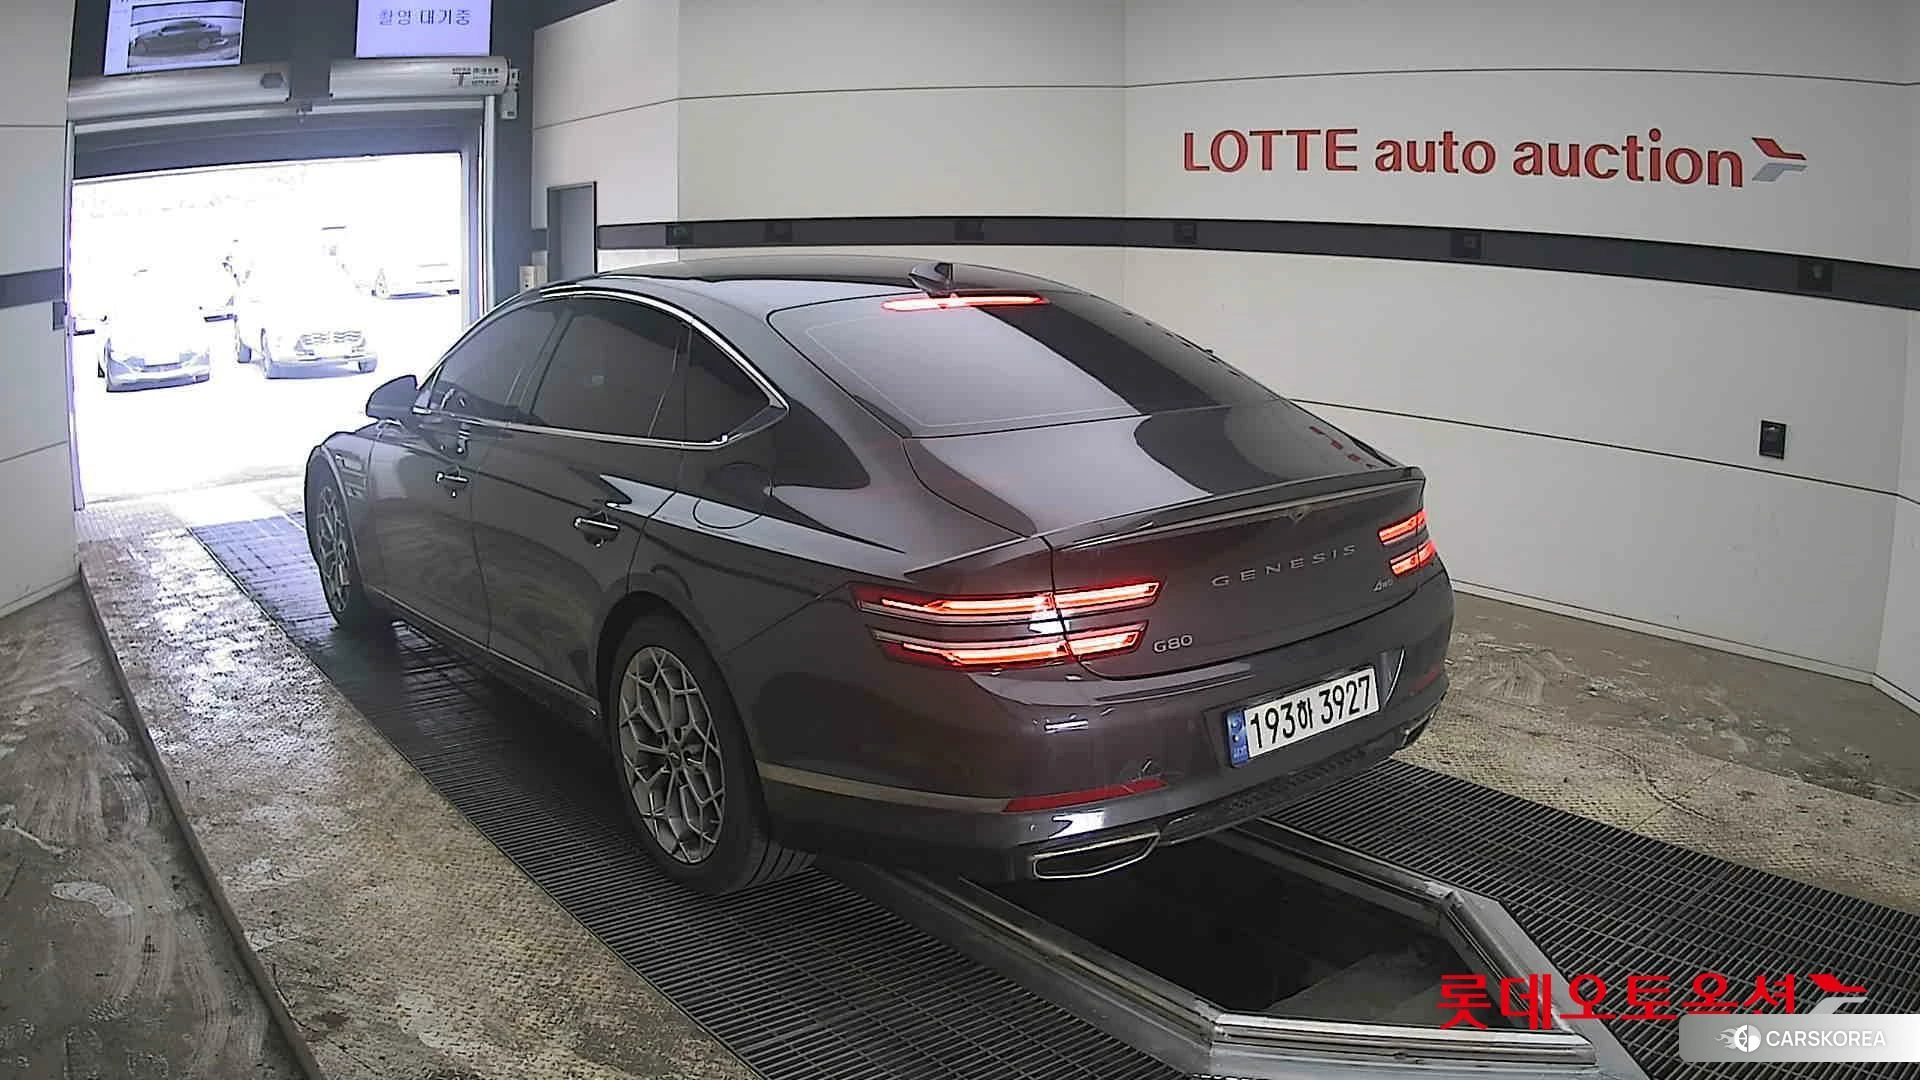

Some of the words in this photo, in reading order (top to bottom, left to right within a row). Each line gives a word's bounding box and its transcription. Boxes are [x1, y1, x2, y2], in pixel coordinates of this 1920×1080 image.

[420, 9, 470, 26] 대기중
[1184, 128, 1358, 172] LOTTE
[1375, 130, 1497, 174] auto
[1512, 128, 1744, 188] auction
[1211, 544, 1357, 588] GENESIS
[1153, 634, 1194, 654] G80
[1250, 697, 1313, 749] 193하
[1319, 675, 1371, 725] 3927
